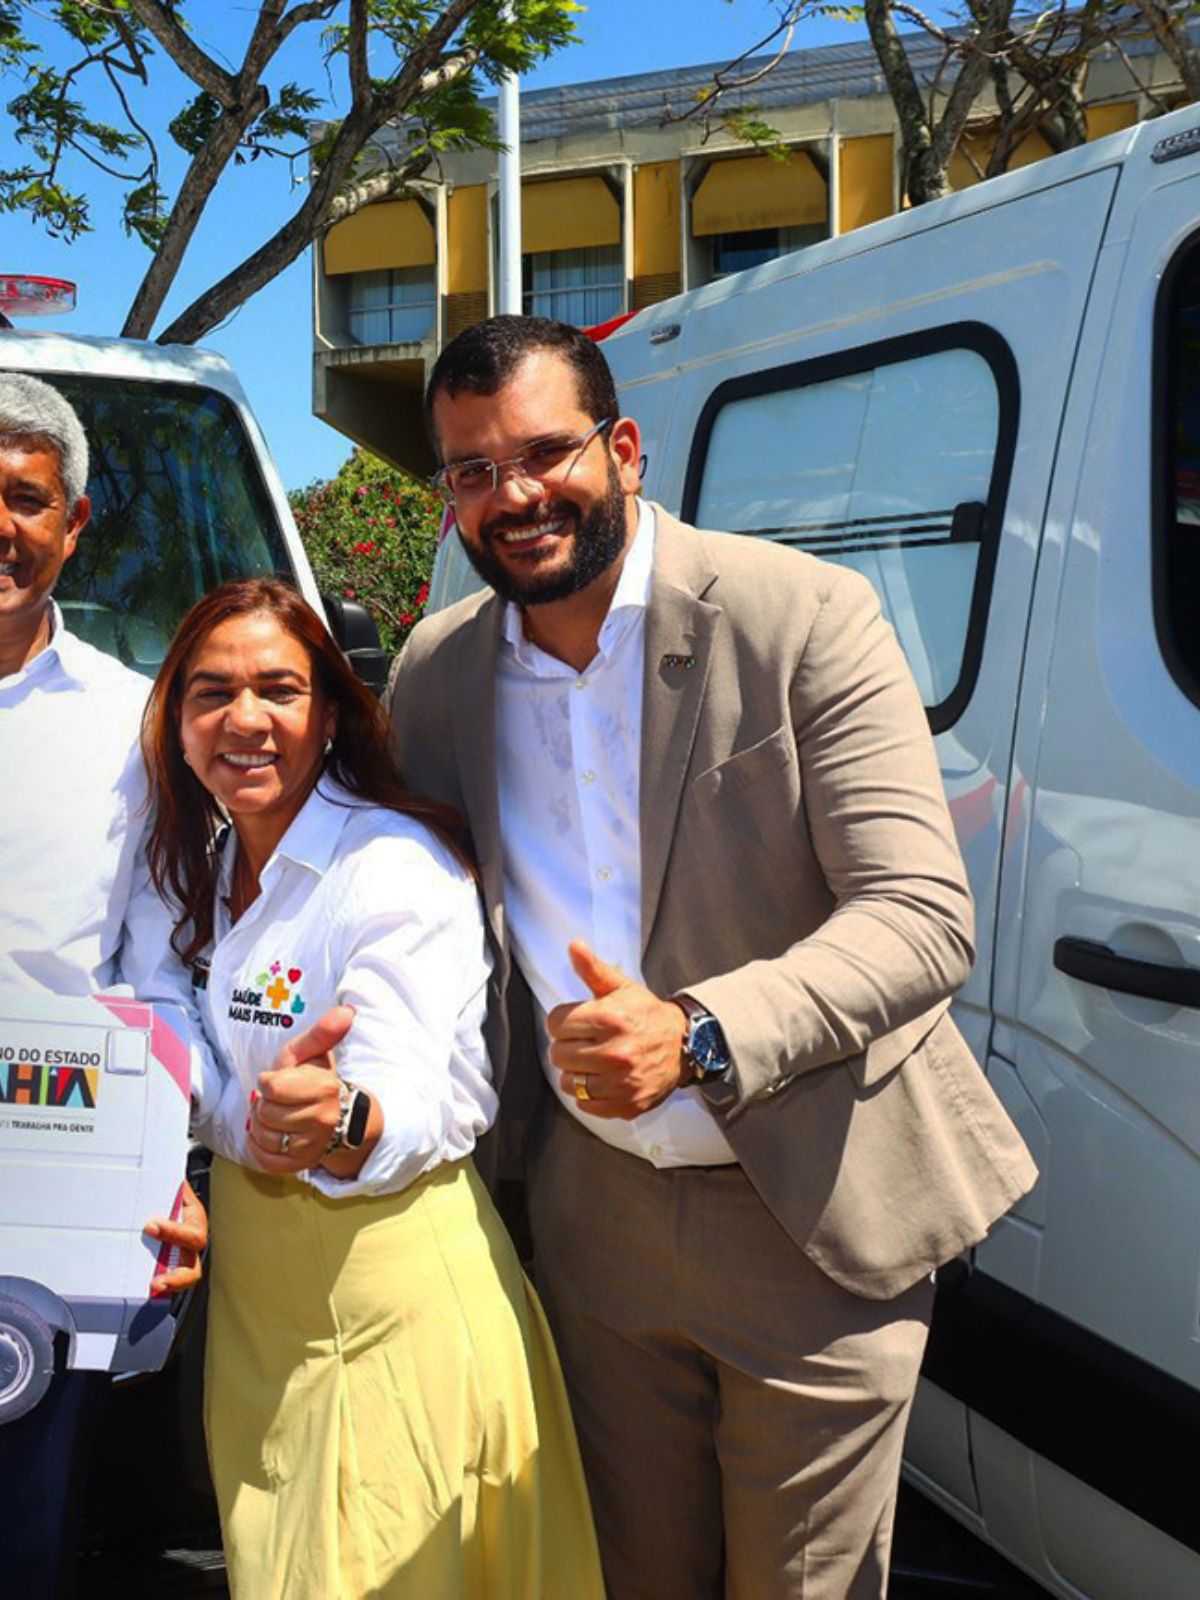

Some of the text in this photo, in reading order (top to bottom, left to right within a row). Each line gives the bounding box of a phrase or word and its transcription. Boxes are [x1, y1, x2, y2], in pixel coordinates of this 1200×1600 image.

[232, 987, 263, 1007] SAÚDE
[228, 1005, 294, 1029] MAIS PERTO
[18, 1048, 40, 1062] DO
[44, 1049, 101, 1066] ESTADO
[11, 1120, 51, 1131] TRABALHA
[52, 1123, 68, 1132] PRA
[69, 1124, 95, 1133] GENTE
